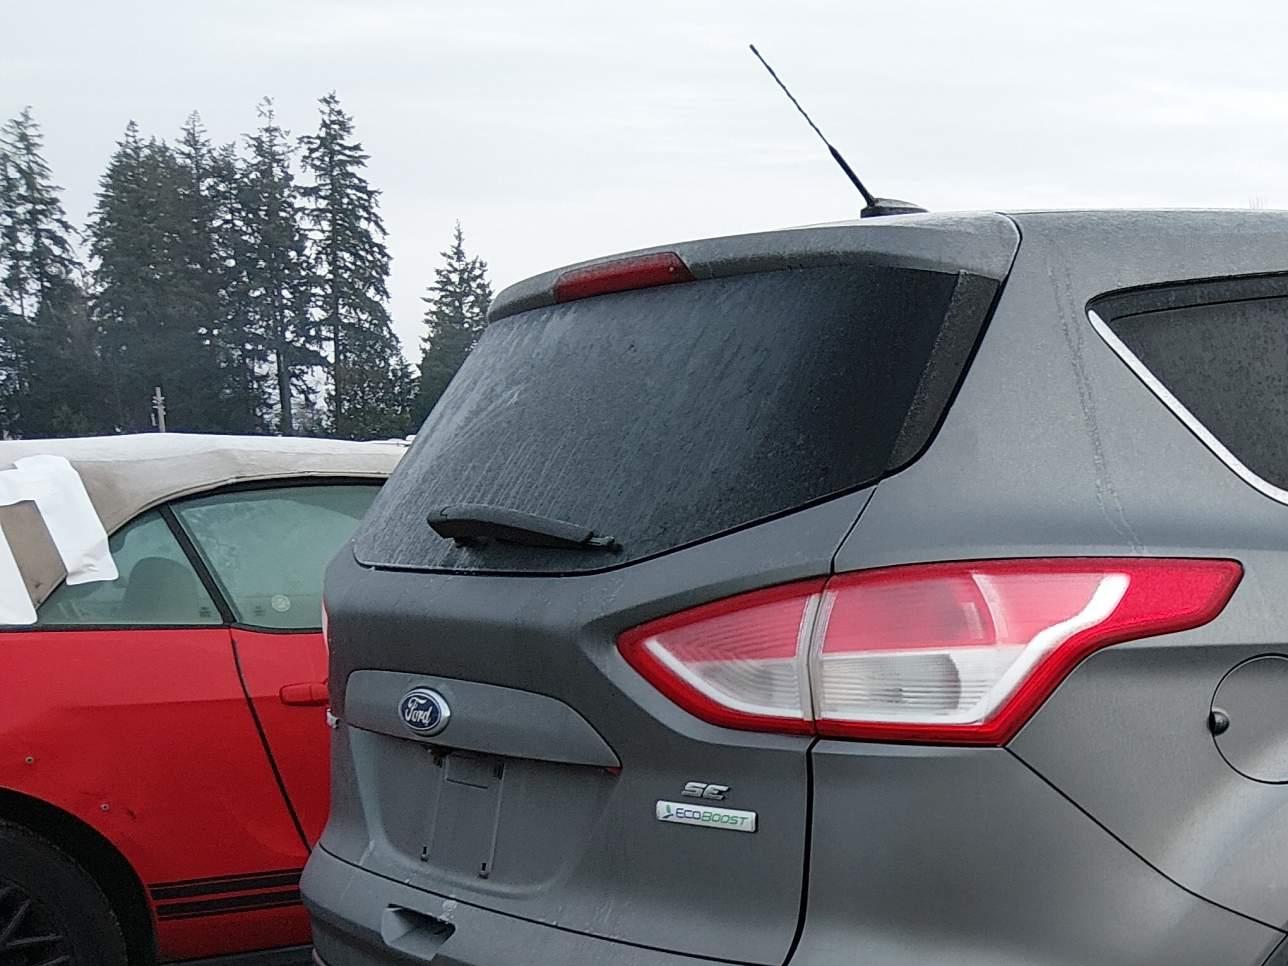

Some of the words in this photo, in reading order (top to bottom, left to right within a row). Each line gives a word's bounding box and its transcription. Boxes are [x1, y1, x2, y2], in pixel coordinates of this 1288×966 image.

[404, 696, 433, 726] Ford
[681, 781, 730, 800] SE
[675, 807, 749, 825] ECOBOOST
